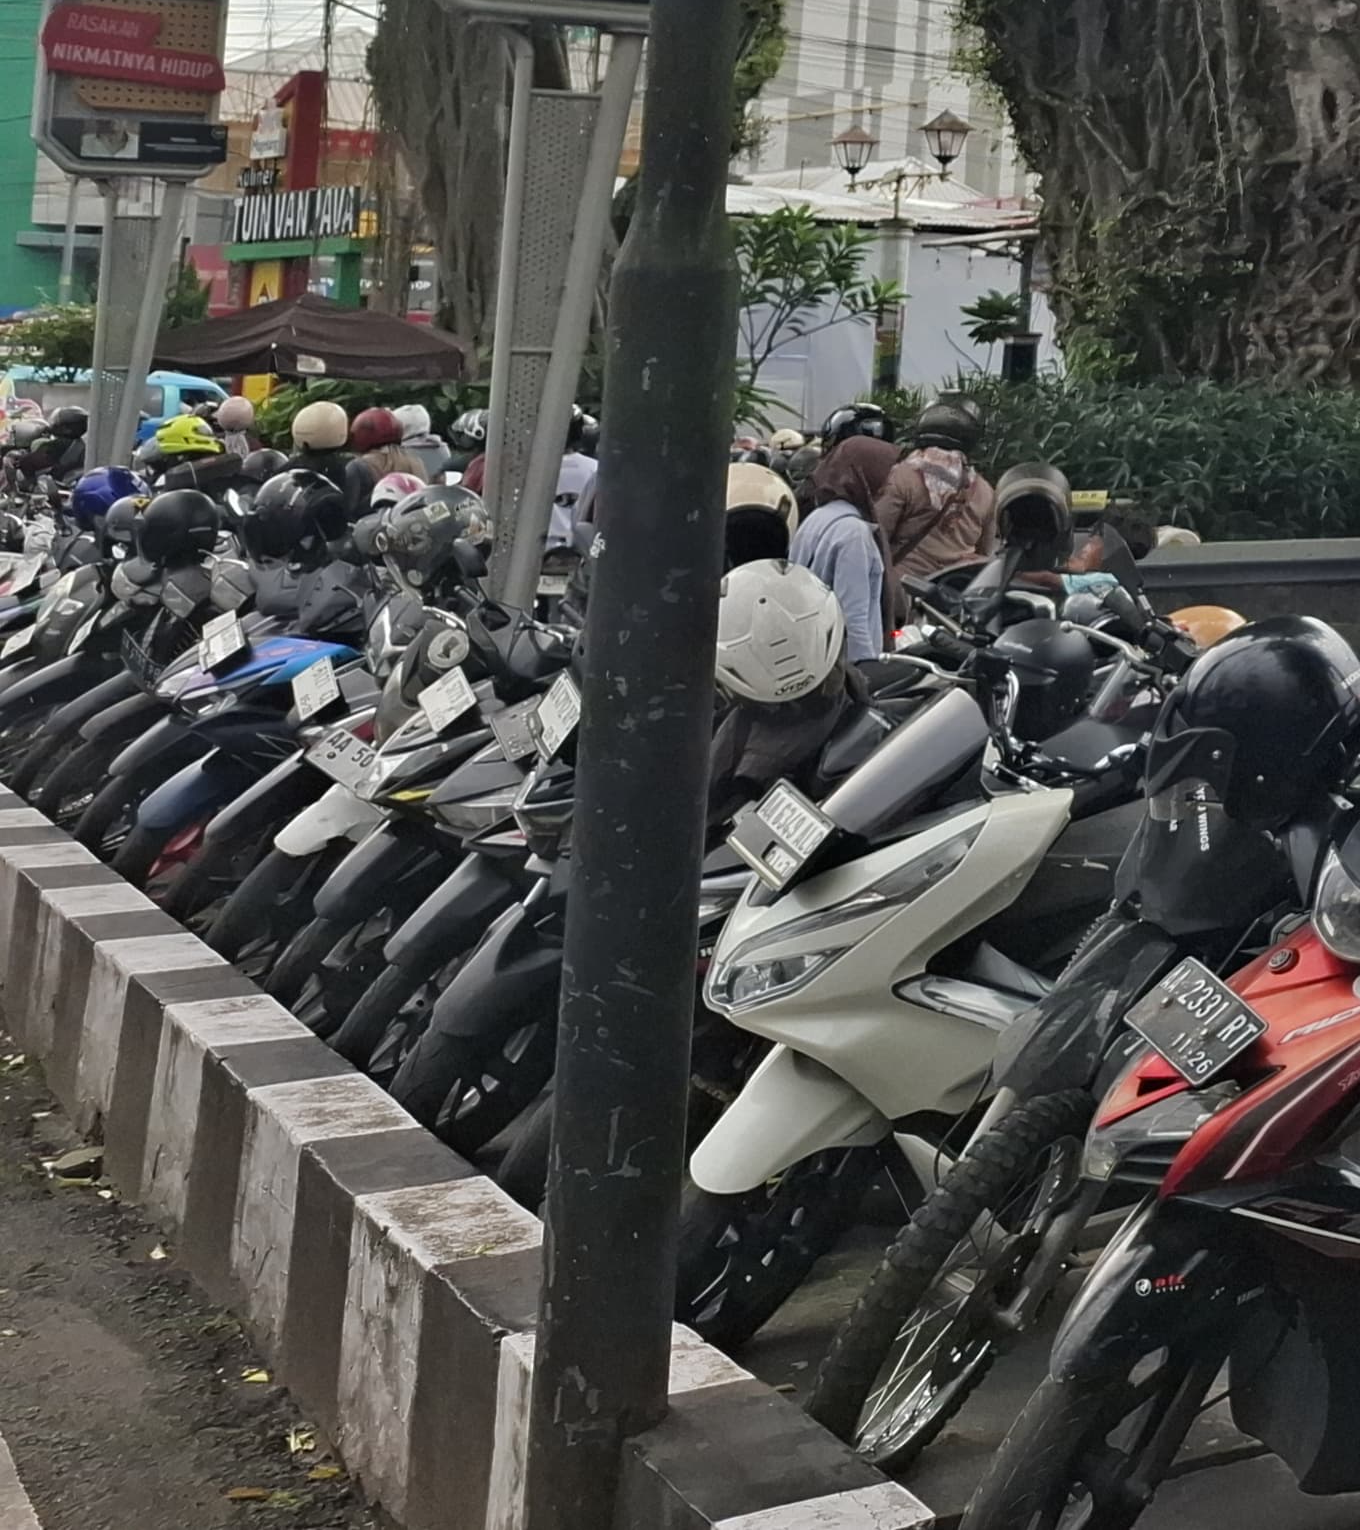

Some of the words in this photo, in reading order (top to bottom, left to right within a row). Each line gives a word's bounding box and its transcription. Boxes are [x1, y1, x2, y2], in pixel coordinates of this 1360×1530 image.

[67, 13, 140, 38] RASAKAN
[52, 43, 155, 71] NIKMATNYA
[161, 58, 214, 78] HIDUP
[233, 194, 272, 241] TUIN
[275, 190, 309, 240] VAN
[327, 731, 345, 753] AA
[1160, 964, 1191, 992] AA
[1177, 979, 1230, 1025] 2331
[1217, 1014, 1258, 1049] RT
